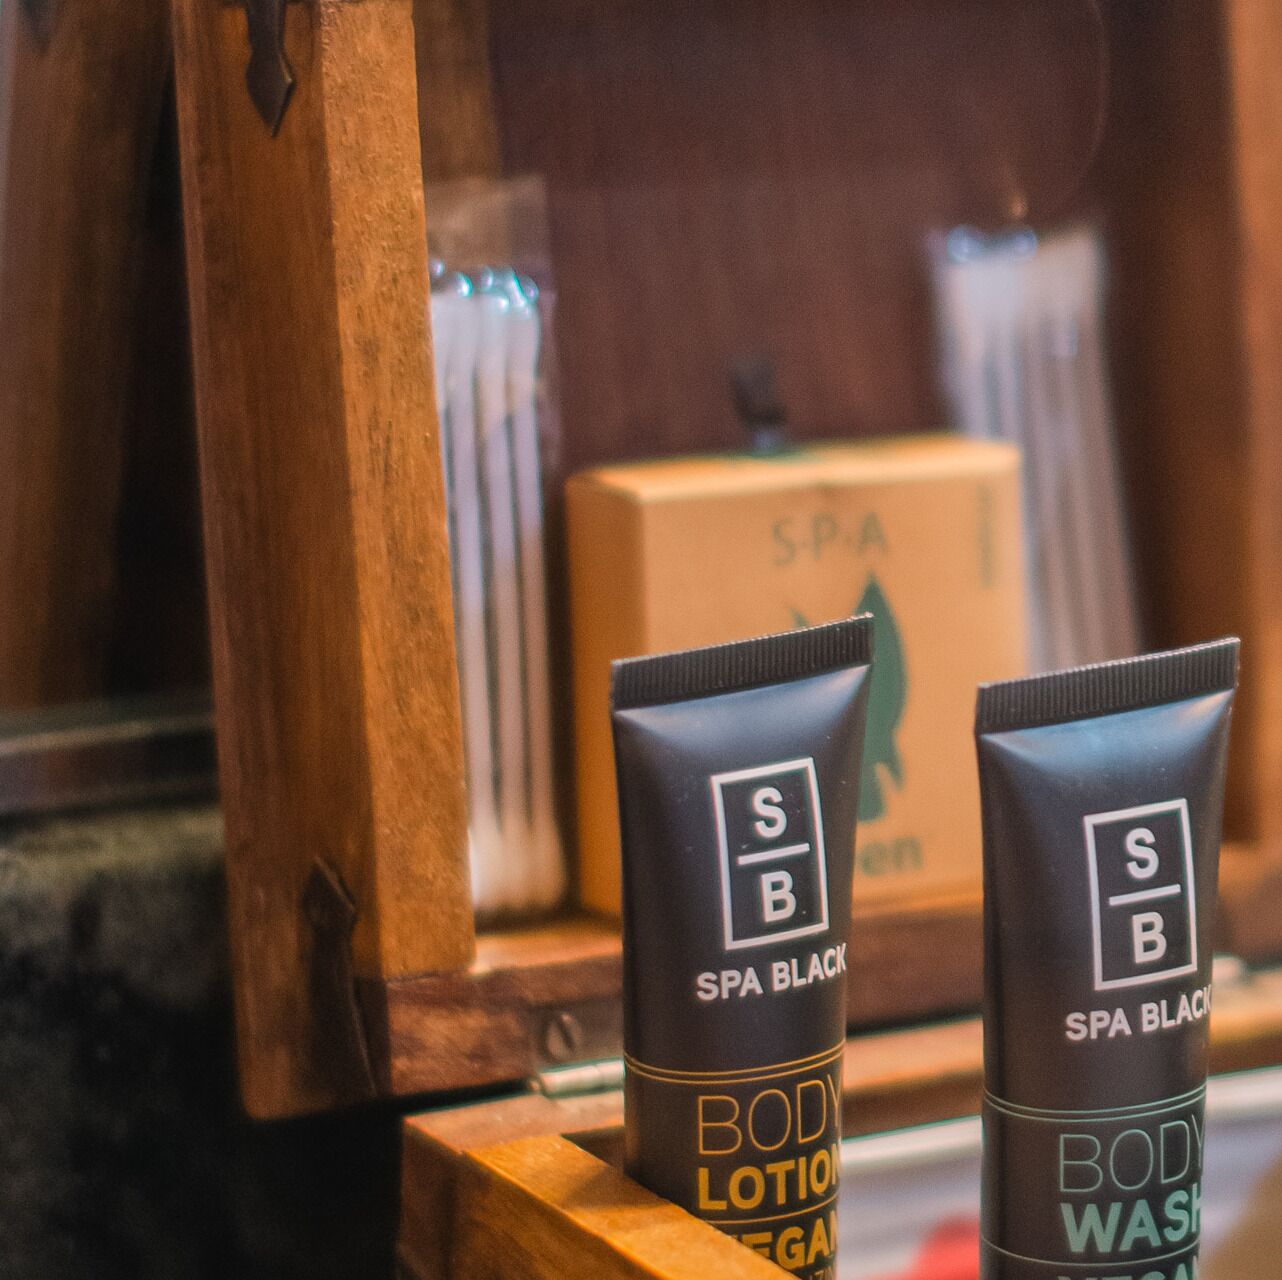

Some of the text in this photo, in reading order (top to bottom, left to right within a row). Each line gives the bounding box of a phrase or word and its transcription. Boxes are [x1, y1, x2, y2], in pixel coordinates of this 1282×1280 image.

[752, 787, 787, 838] S
[1126, 827, 1158, 880] S
[761, 871, 796, 922] B
[1132, 912, 1167, 964] B
[697, 942, 847, 1000] SPA BLACK
[1065, 984, 1212, 1041] SPA BLACK
